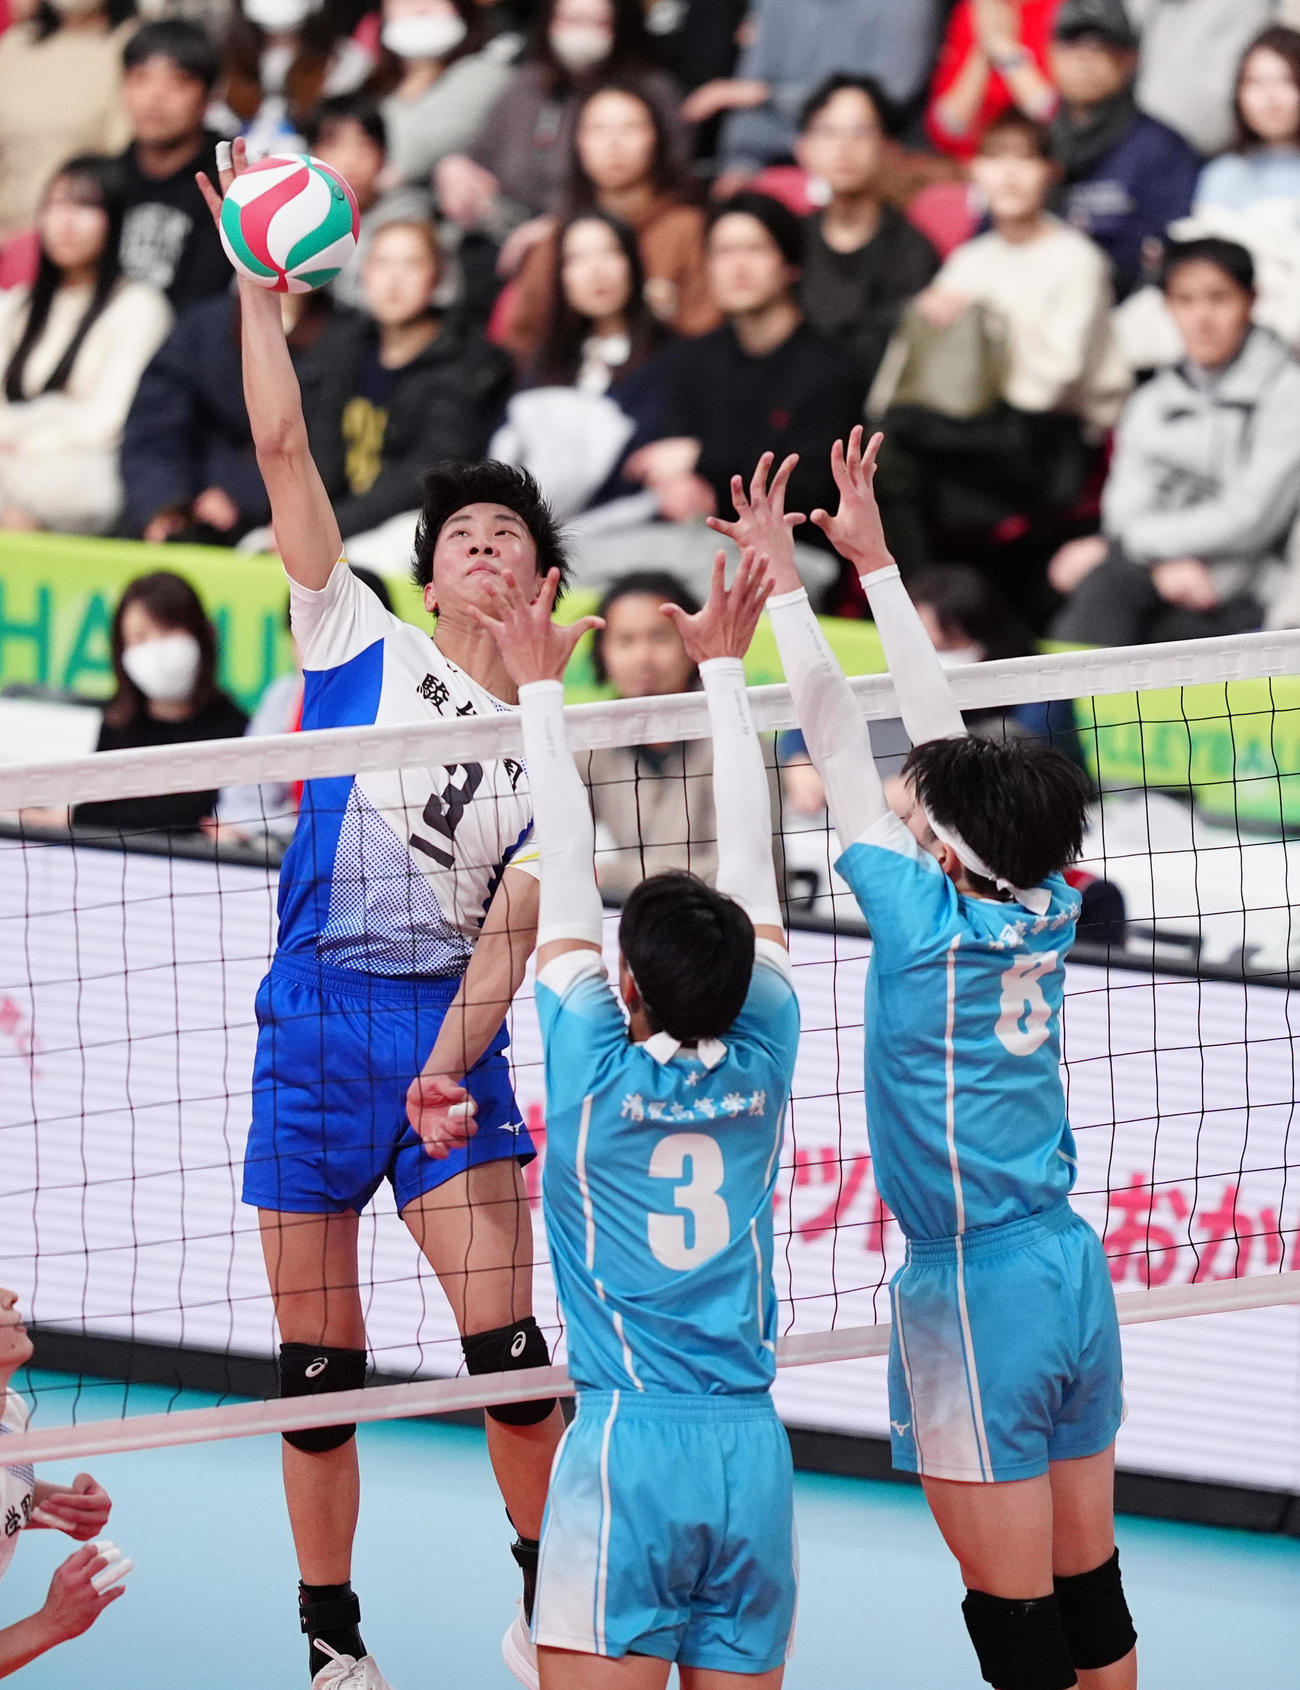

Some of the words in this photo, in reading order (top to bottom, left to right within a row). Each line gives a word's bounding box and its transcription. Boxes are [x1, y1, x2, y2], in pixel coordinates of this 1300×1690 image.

[0, 580, 280, 715] HAU
[994, 951, 1059, 1057] 6
[647, 1132, 730, 1271] 3
